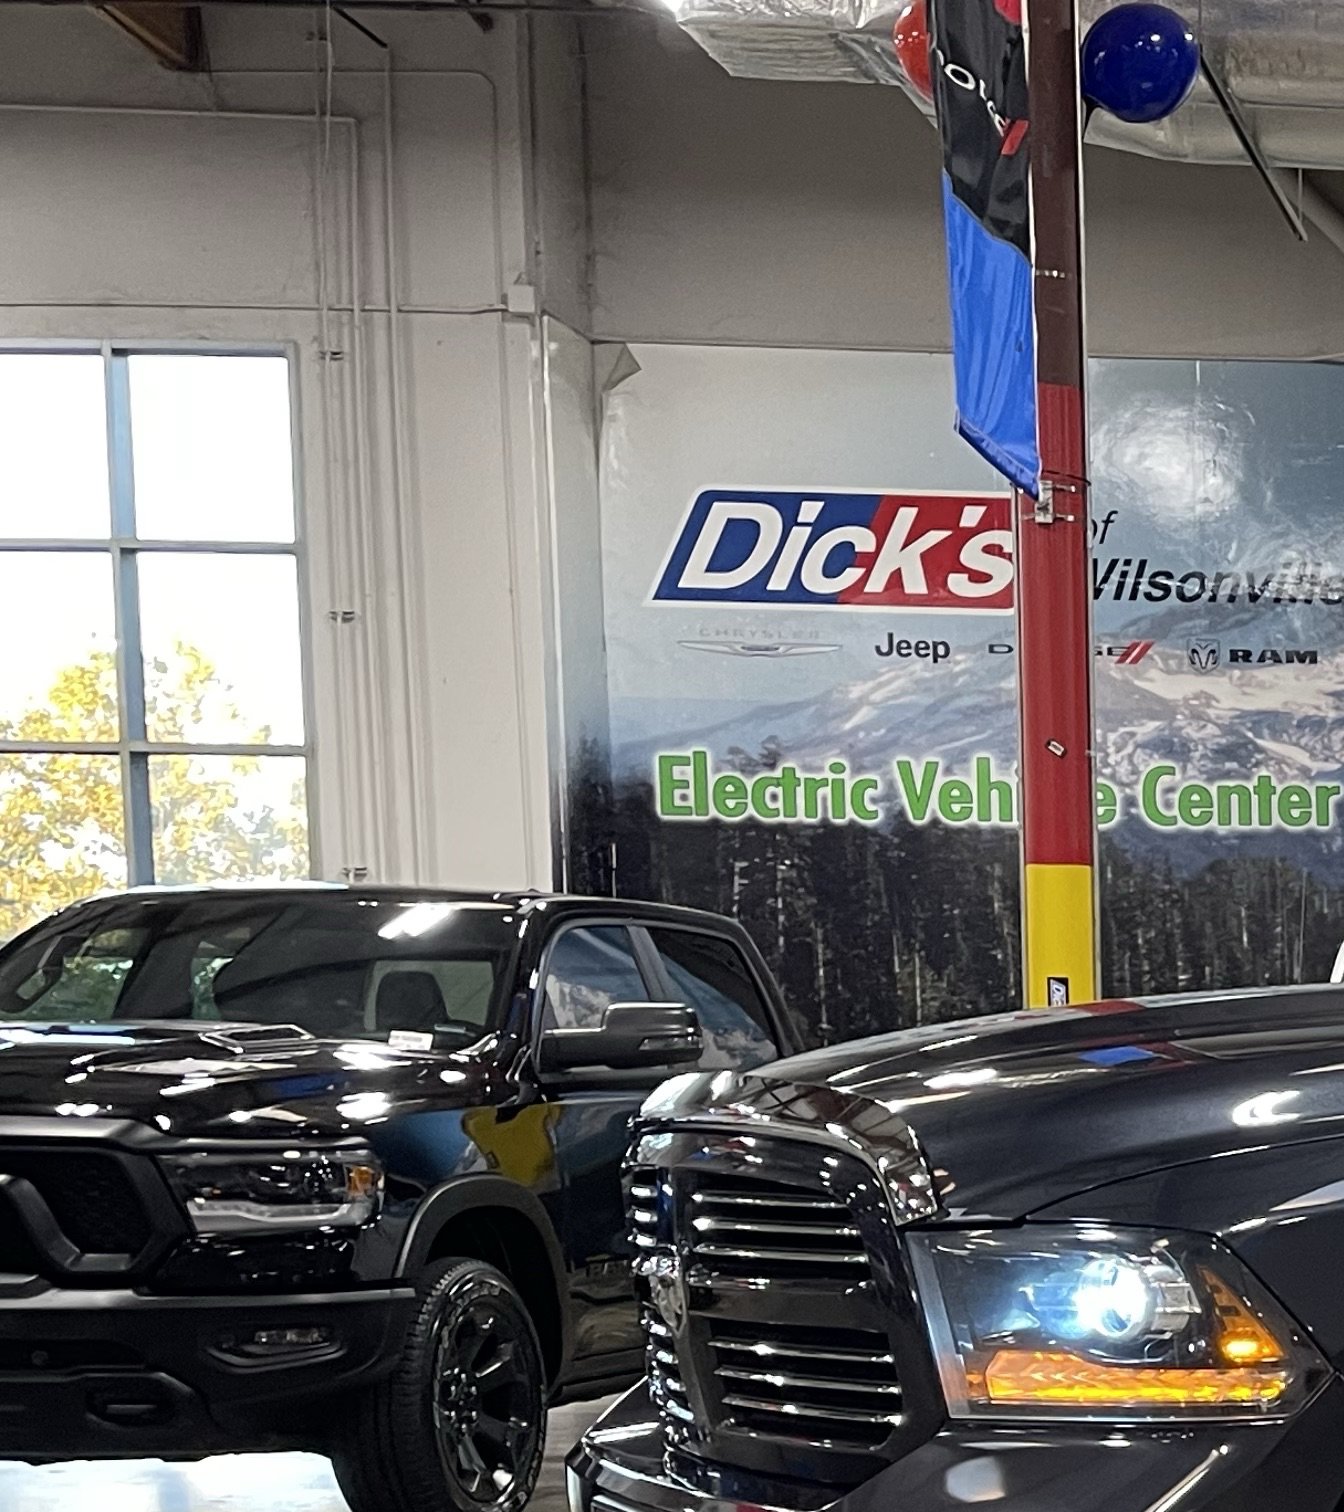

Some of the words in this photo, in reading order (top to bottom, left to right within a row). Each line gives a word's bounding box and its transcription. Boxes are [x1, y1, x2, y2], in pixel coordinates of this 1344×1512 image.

[1091, 510, 1118, 545] f
[677, 500, 1014, 598] Dick's
[874, 632, 951, 664] Jeep
[1229, 649, 1318, 665] RAM
[658, 750, 879, 821] Electric
[896, 757, 1117, 825] Vehe
[1143, 765, 1341, 827] Center
